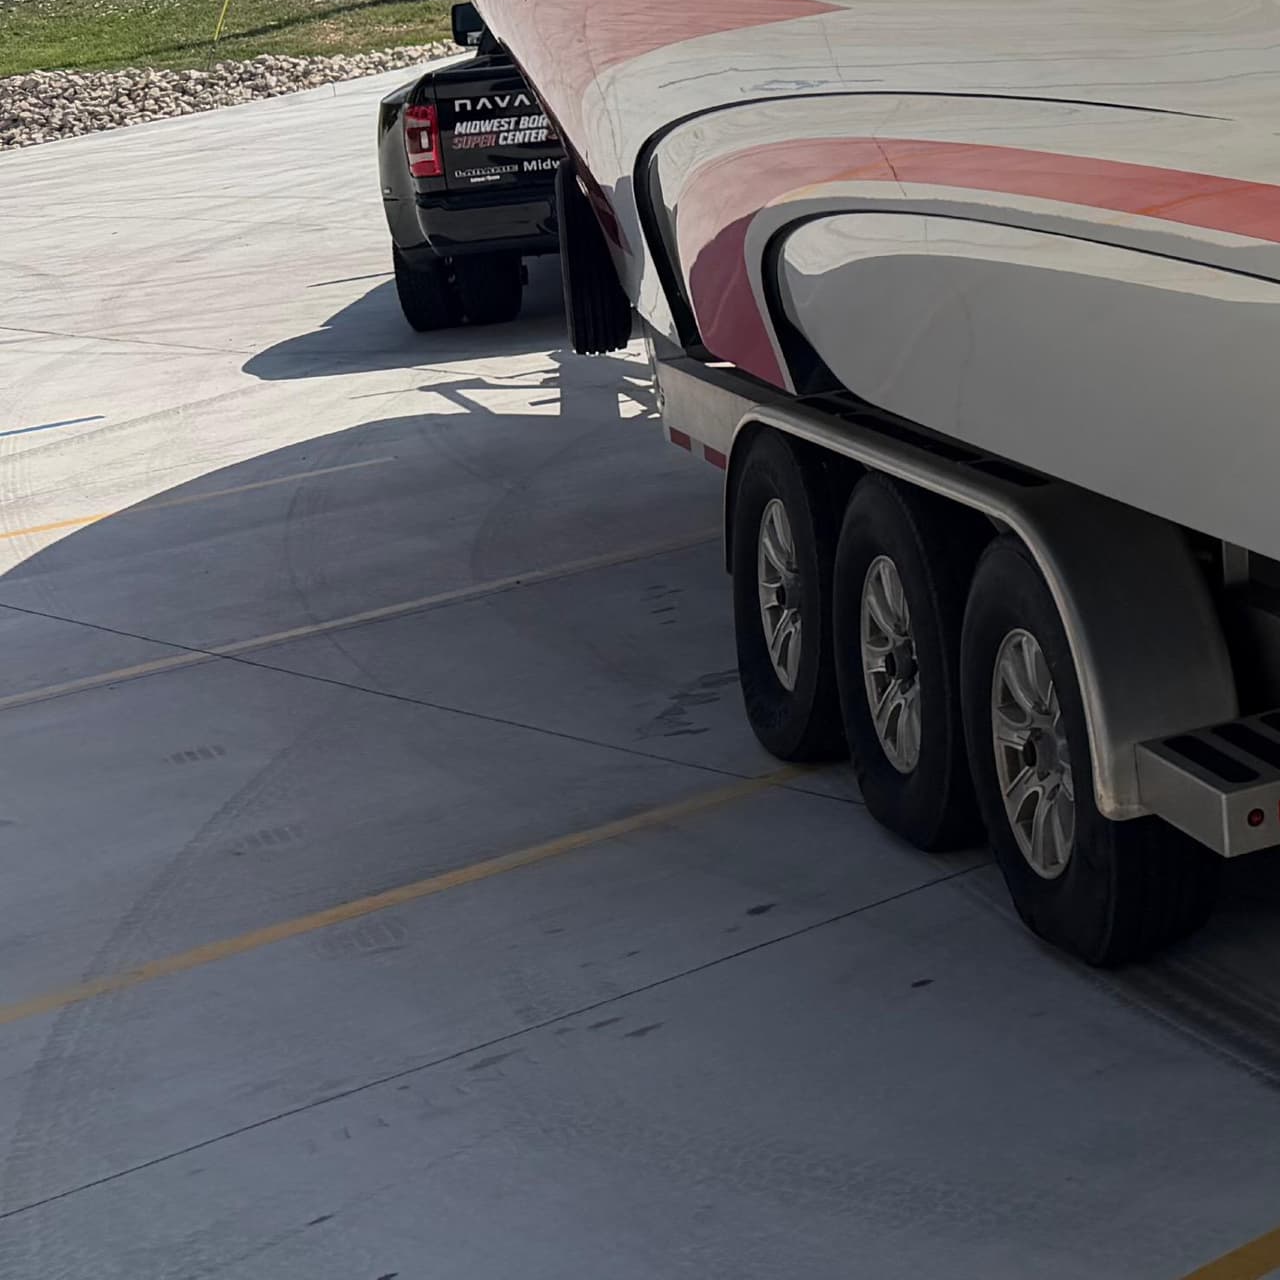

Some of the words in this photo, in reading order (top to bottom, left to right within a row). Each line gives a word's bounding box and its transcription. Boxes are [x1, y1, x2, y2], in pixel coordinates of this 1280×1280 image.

[455, 117, 518, 135] MIDWEST
[452, 133, 497, 150] SUPER
[498, 129, 548, 146] CENTER
